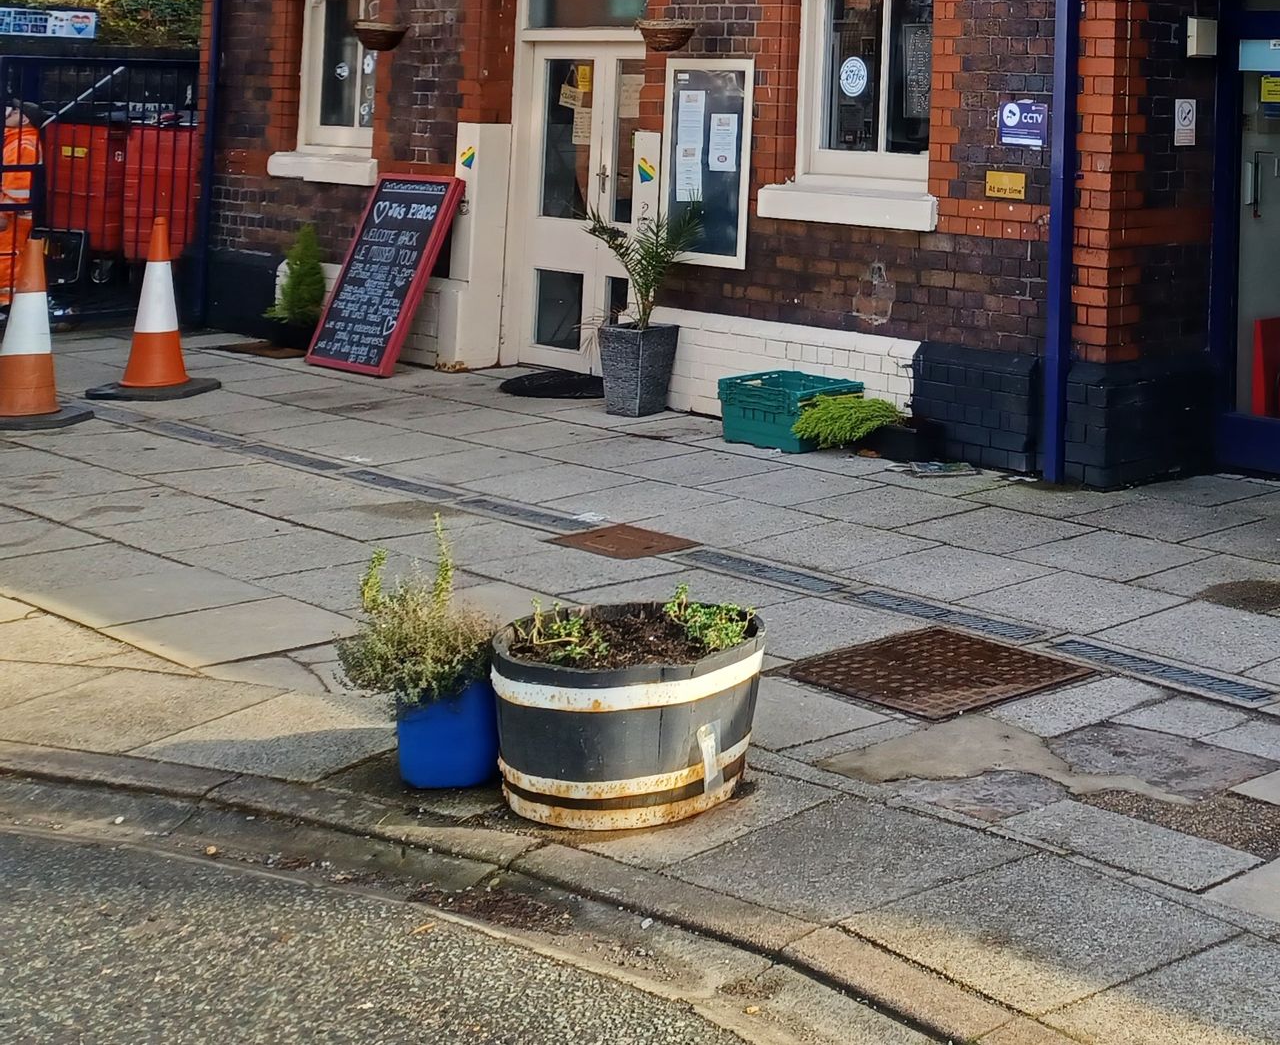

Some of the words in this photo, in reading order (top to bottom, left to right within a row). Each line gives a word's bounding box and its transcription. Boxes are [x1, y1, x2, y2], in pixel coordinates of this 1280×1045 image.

[1022, 112, 1043, 123] CCTV
[1009, 186, 1022, 194] time
[388, 203, 406, 219] Jo's
[407, 203, 437, 220] Place
[362, 228, 398, 244] WELCOME
[397, 230, 420, 246] BACK
